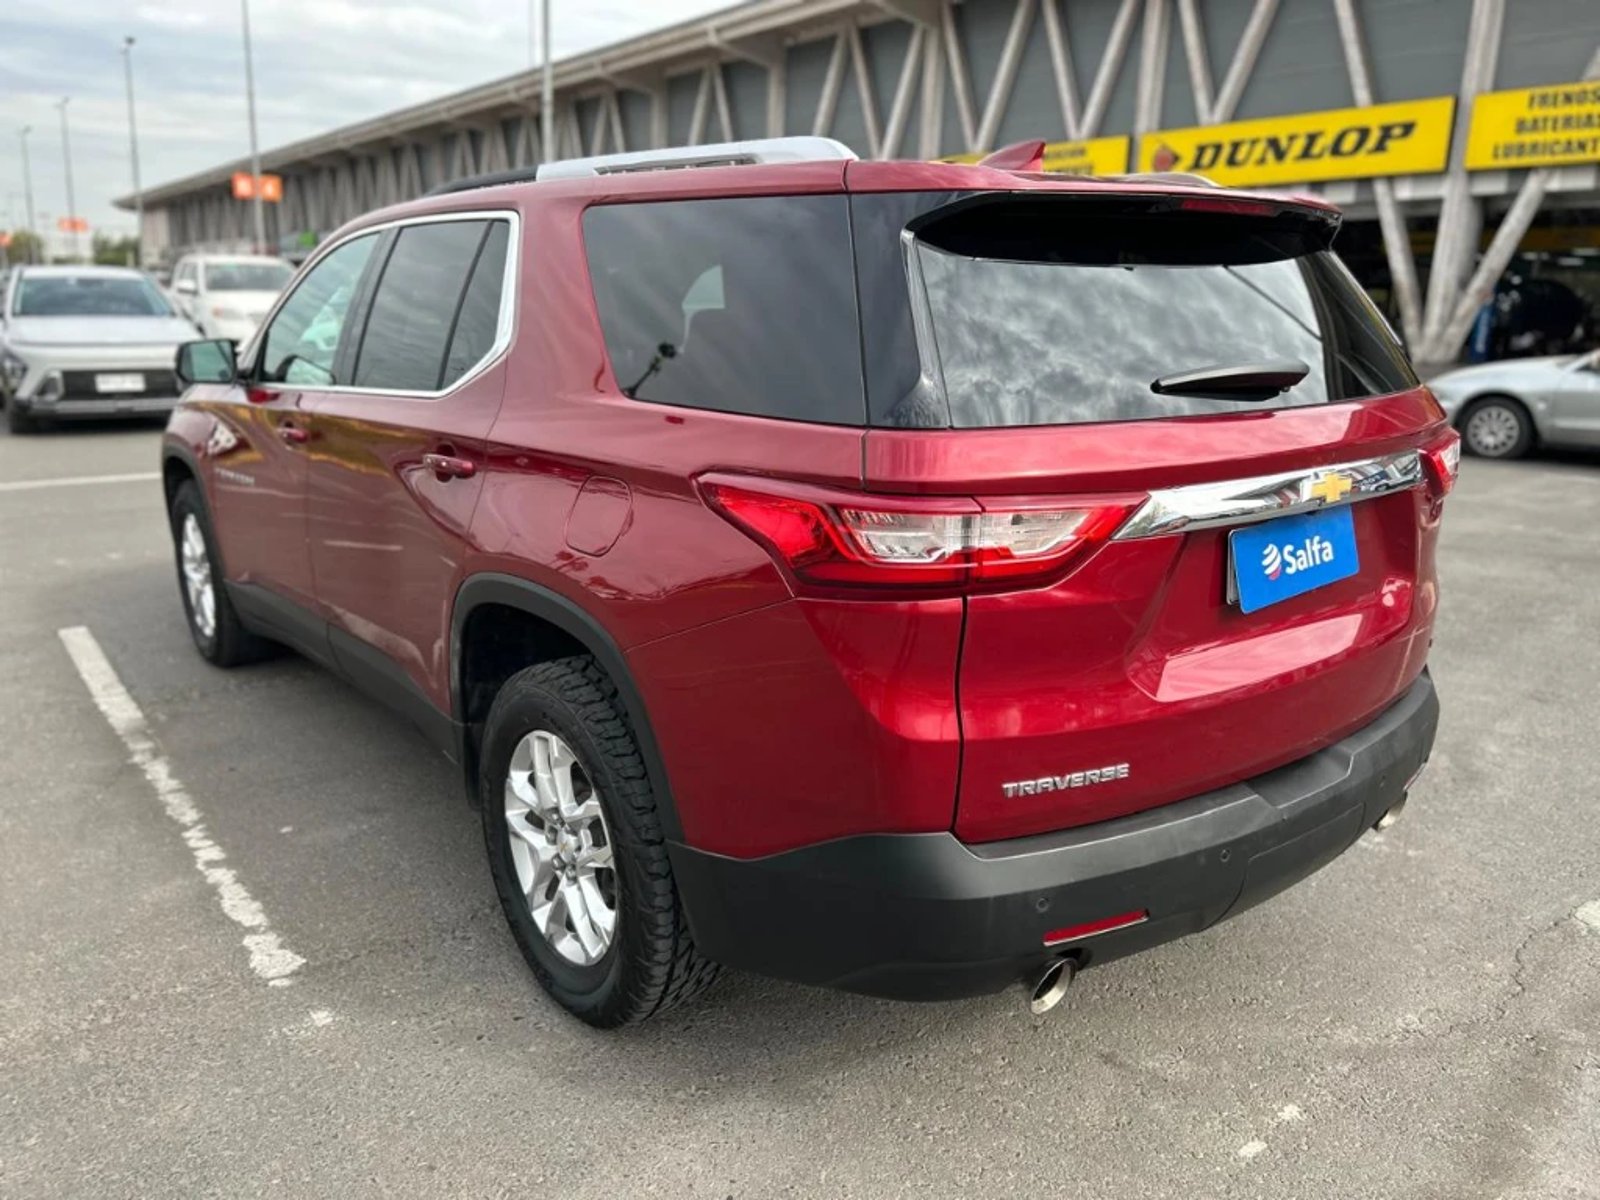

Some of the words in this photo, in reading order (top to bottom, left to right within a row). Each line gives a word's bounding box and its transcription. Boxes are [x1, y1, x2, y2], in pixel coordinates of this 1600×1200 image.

[1515, 112, 1600, 134] BATERIA
[1189, 121, 1417, 171] DUNLOP
[1283, 535, 1334, 575] Salfa
[1002, 762, 1130, 798] TRAVERSE
